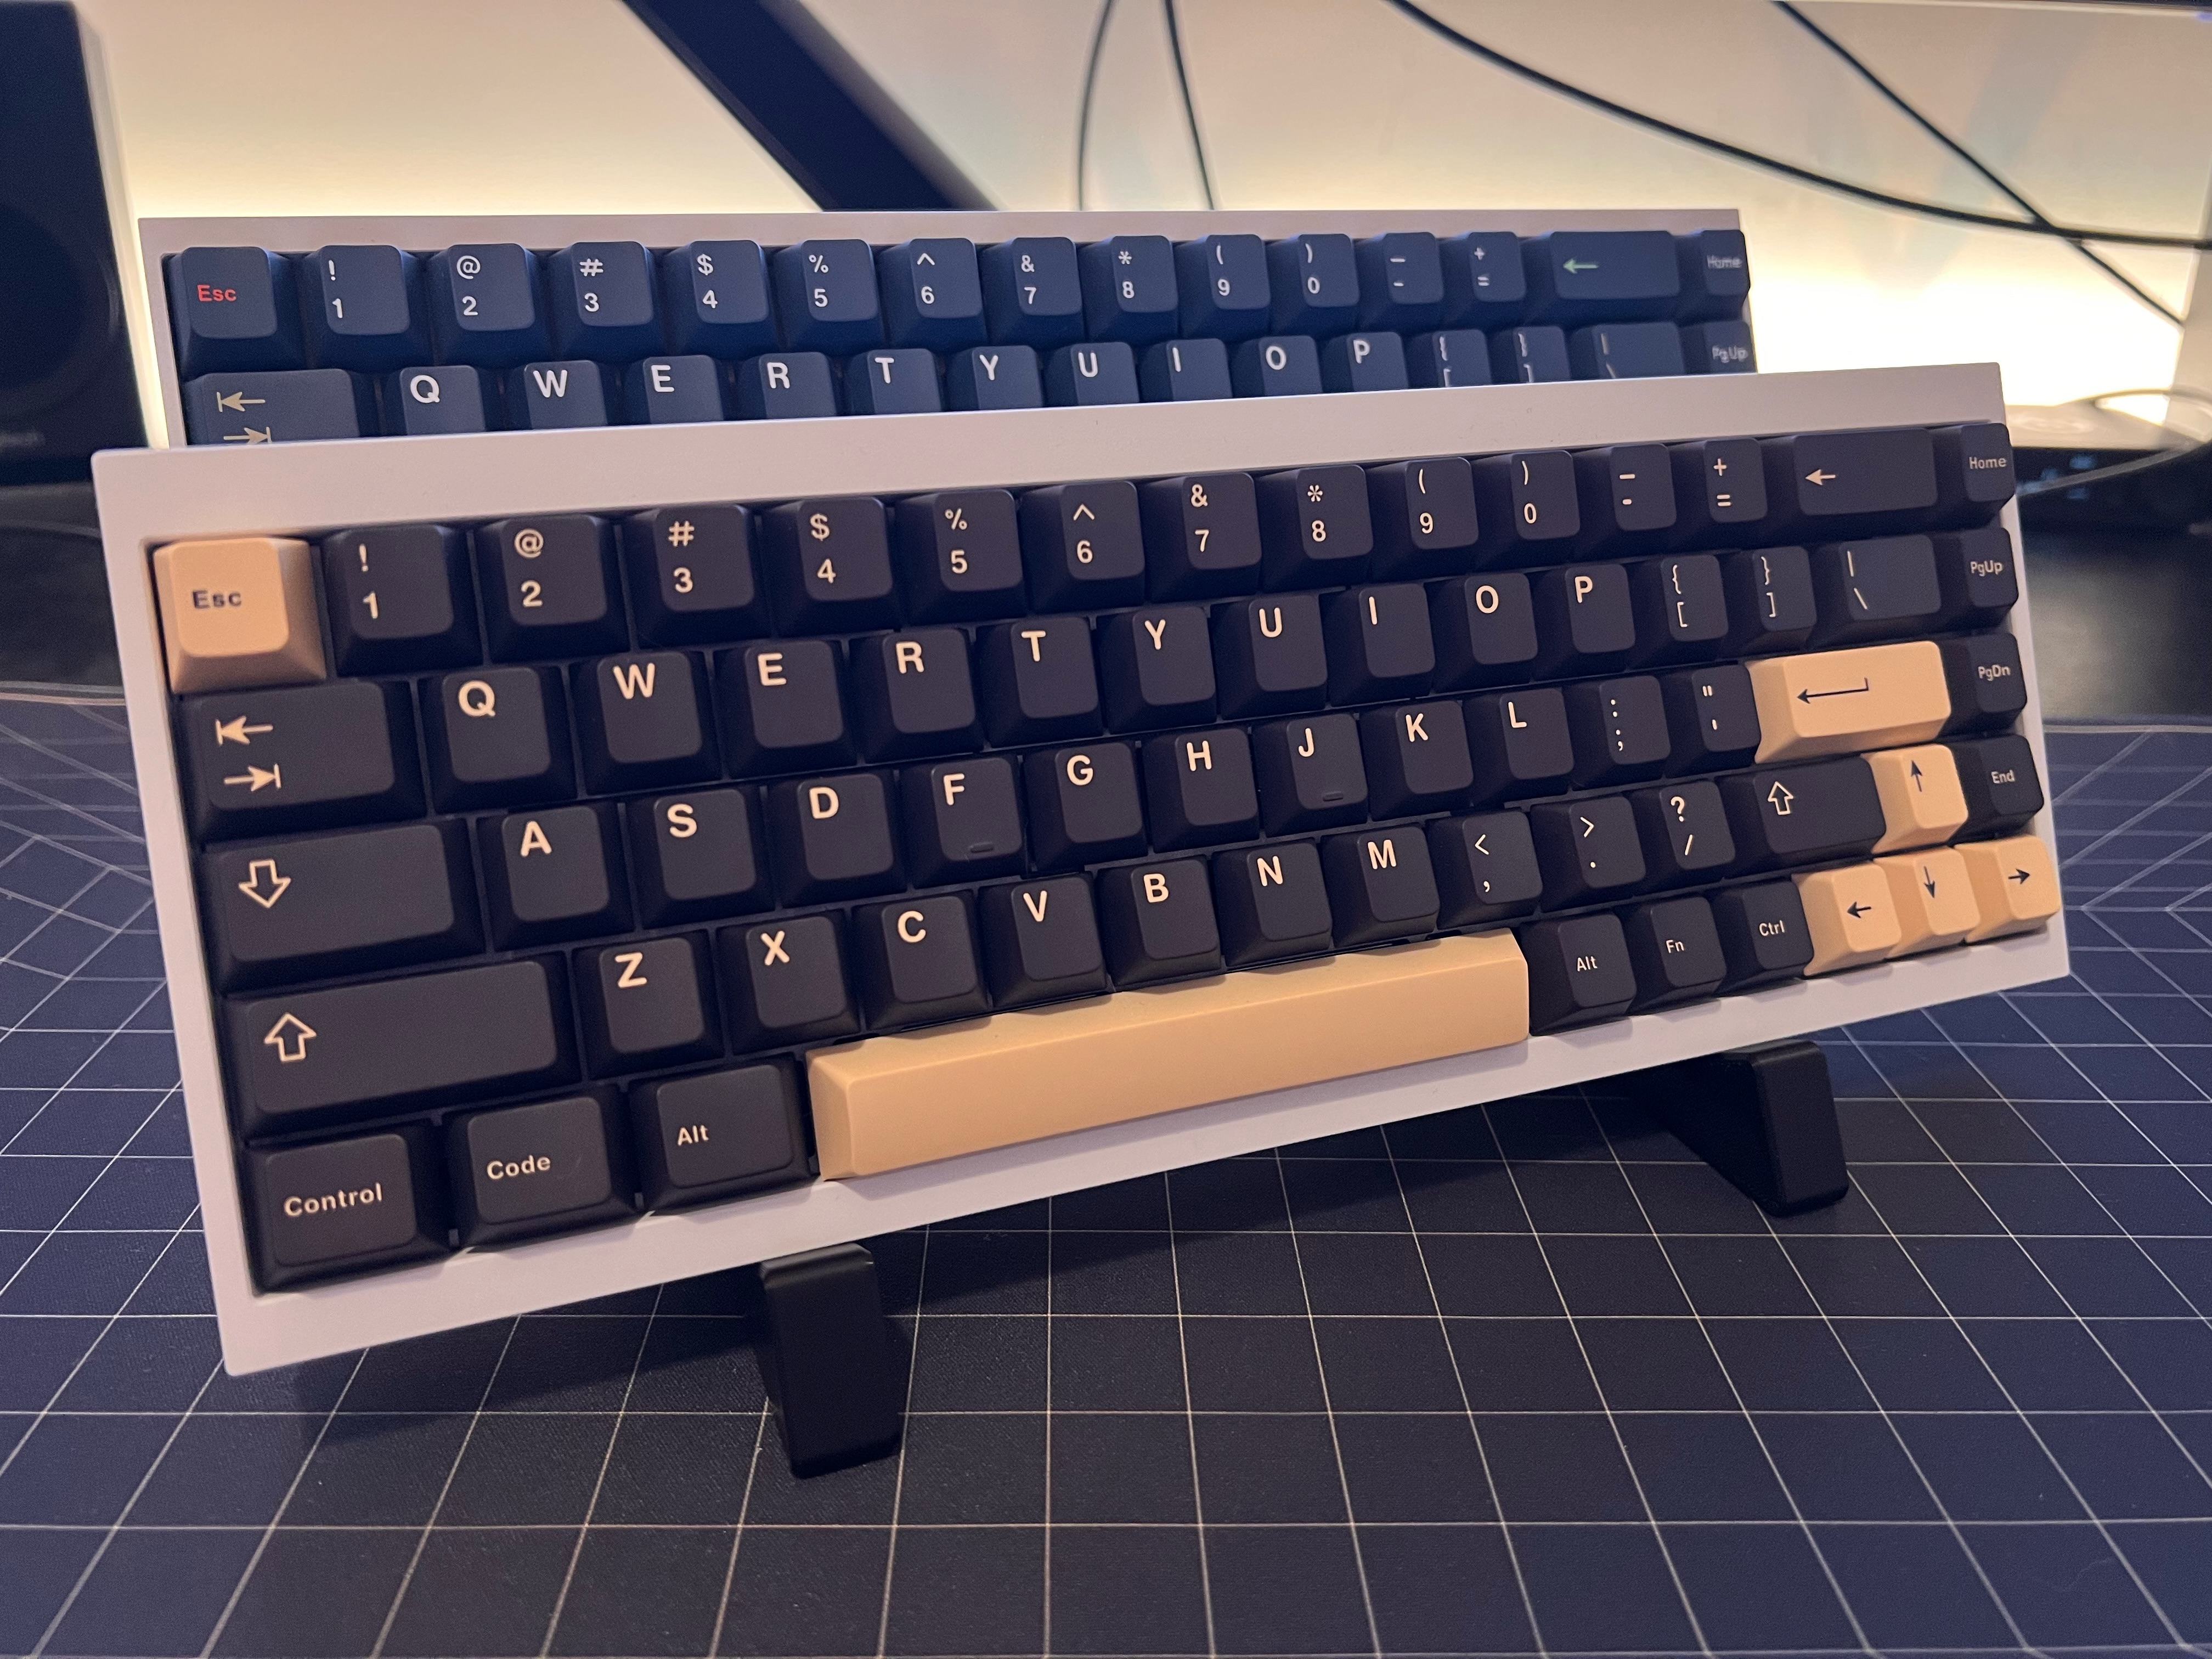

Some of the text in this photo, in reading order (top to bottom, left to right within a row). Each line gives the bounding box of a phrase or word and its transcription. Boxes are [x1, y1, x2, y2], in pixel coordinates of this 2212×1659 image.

[697, 253, 714, 276] $
[809, 255, 829, 273] %
[917, 253, 935, 266] ^
[1021, 255, 1035, 272] &
[1216, 245, 1223, 265] (
[1305, 243, 1313, 263] )
[1474, 247, 1485, 260] +
[328, 260, 336, 281] !
[456, 255, 481, 280] @
[579, 258, 604, 276] #
[197, 284, 236, 302] Esc
[1122, 281, 1135, 298] 8
[1217, 278, 1230, 296] 9
[1307, 276, 1320, 294] 0
[1477, 276, 1489, 286] =
[462, 296, 478, 316] 2
[584, 292, 599, 312] 3
[702, 290, 718, 309] 4
[814, 288, 828, 307] 5
[921, 286, 935, 304] 6
[1024, 286, 1037, 304] 7
[332, 298, 343, 319] 1
[1172, 347, 1181, 372] I
[1266, 346, 1286, 370] O
[1353, 339, 1370, 364] P
[767, 362, 790, 389] R
[874, 357, 894, 384] T
[979, 354, 998, 381] Y
[1078, 352, 1098, 377] U
[410, 375, 440, 403] Q
[533, 369, 568, 398] W
[651, 364, 675, 392] E
[1521, 460, 1528, 485] )
[1713, 458, 1727, 476] +
[1969, 456, 2007, 470] Home
[1419, 469, 1426, 494] (
[1190, 484, 1208, 507] &
[1717, 494, 1731, 506] =
[945, 508, 967, 530] %
[1073, 504, 1095, 521] ^
[1420, 512, 1433, 534] 9
[1524, 503, 1537, 524] 0
[668, 521, 695, 547] #
[810, 514, 830, 541] $
[1312, 520, 1326, 542] 8
[514, 529, 544, 558] @
[1077, 540, 1093, 563] 6
[1195, 529, 1209, 552] 7
[359, 544, 369, 572] !
[817, 558, 836, 583] 4
[951, 550, 968, 574] 5
[1760, 556, 1770, 585] }
[1970, 560, 2003, 577] PgUp
[674, 567, 693, 593] 3
[1575, 576, 1593, 603] P
[1672, 565, 1681, 595] {
[192, 590, 241, 609] Esc
[363, 592, 378, 619] 1
[521, 580, 543, 607] 2
[1476, 585, 1499, 613] O
[1766, 592, 1776, 618] ]
[1259, 607, 1282, 637] U
[1369, 596, 1378, 625] I
[1677, 601, 1688, 628] [
[1021, 630, 1046, 662] T
[1144, 619, 1166, 650] Y
[758, 653, 787, 686] E
[896, 641, 924, 674] R
[613, 663, 655, 699] W
[1978, 664, 2011, 681] PgDn
[459, 680, 495, 716] Q
[1611, 699, 1618, 718] :
[1508, 701, 1527, 728] L
[1406, 713, 1429, 742] K
[1616, 729, 1623, 751] ;
[1298, 727, 1314, 757] J
[1187, 740, 1212, 771] H
[1066, 755, 1093, 786] G
[1991, 770, 2015, 784] End
[944, 774, 965, 805] F
[809, 787, 839, 819] D
[1671, 796, 1685, 822] ?
[667, 804, 697, 838] S
[1580, 816, 1594, 838] >
[521, 821, 552, 857] A
[1475, 834, 1489, 855] <
[1367, 839, 1397, 870] M
[1257, 856, 1283, 887] N
[1143, 873, 1169, 903] B
[1023, 890, 1047, 922] V
[898, 911, 926, 943] C
[1759, 920, 1785, 936] Ctrl
[761, 930, 790, 966] X
[1666, 939, 1684, 953] Fn
[615, 952, 647, 988] Z
[1577, 956, 1598, 972] Alt
[678, 1125, 709, 1146] Alt
[487, 1155, 551, 1180] Code
[284, 1183, 382, 1217] Control
